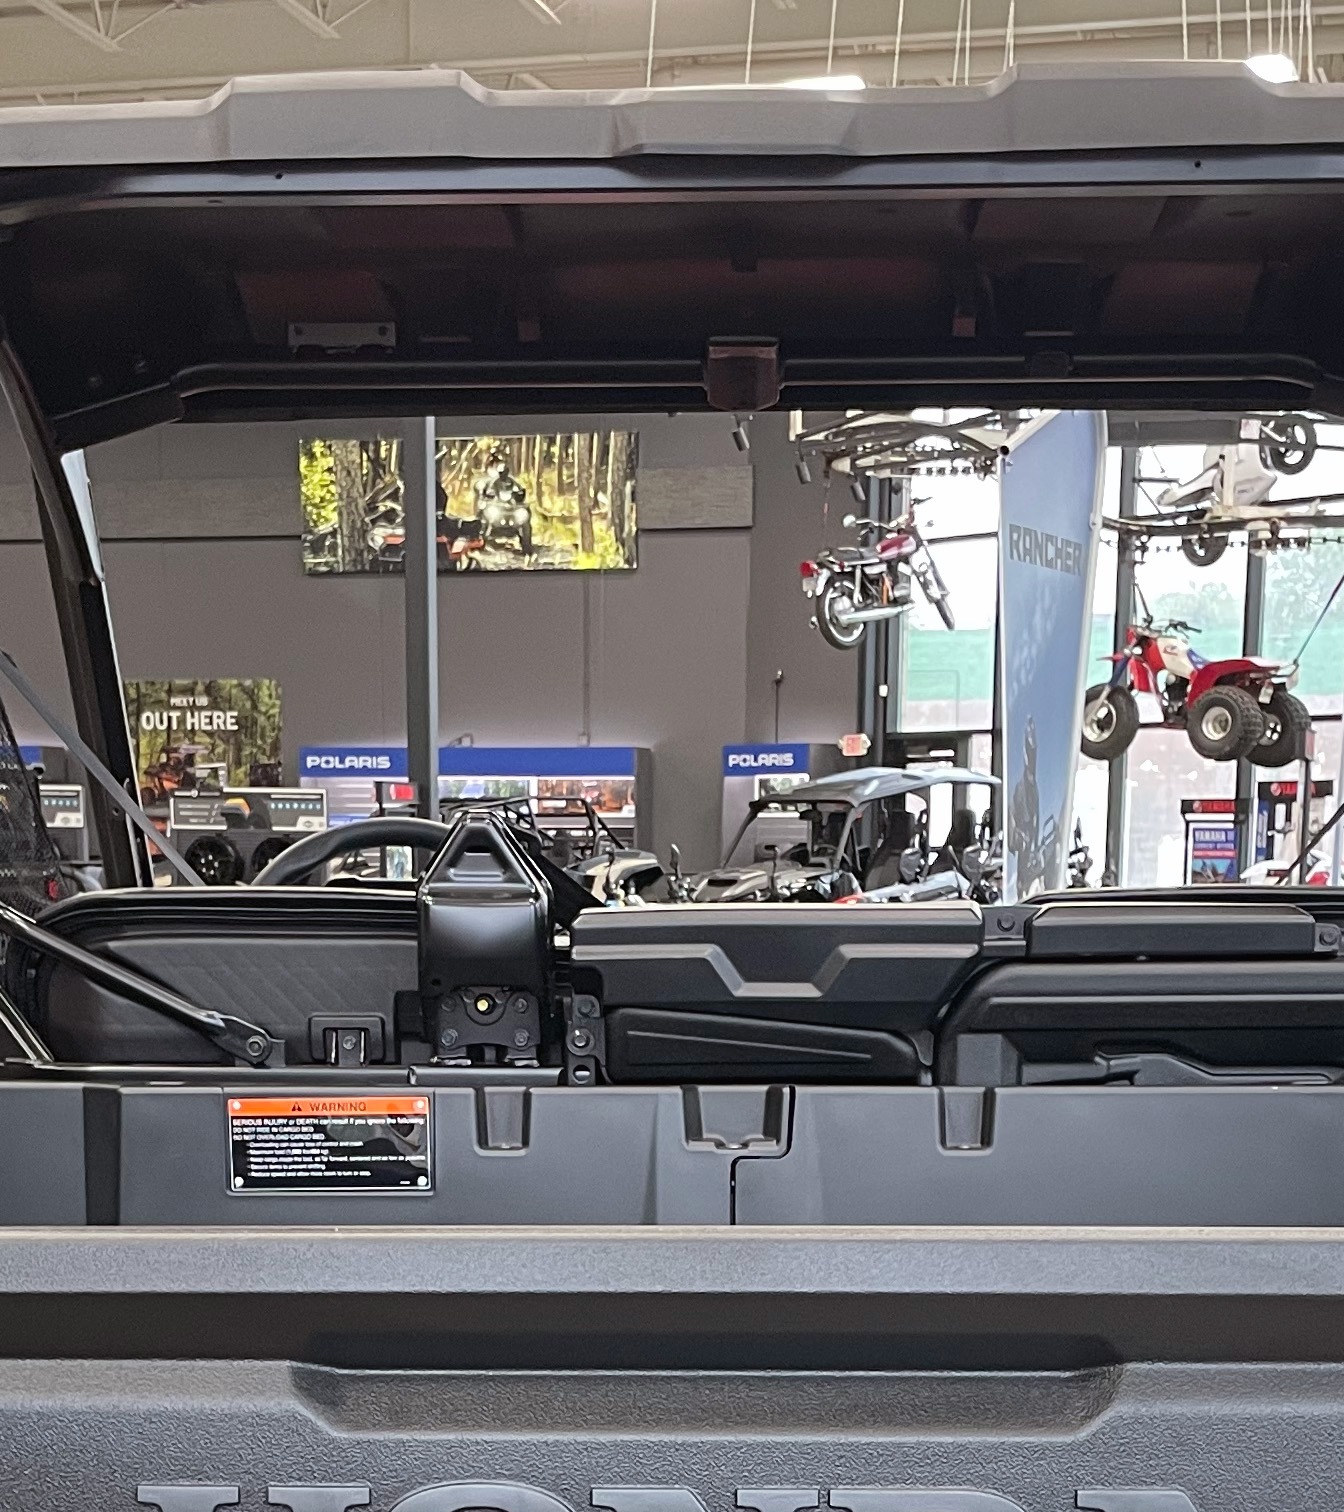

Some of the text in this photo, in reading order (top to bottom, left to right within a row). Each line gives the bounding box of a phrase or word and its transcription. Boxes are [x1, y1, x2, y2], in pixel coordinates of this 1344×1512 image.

[1008, 523, 1084, 577] RANCHER
[141, 711, 239, 731] OUT HERE
[306, 756, 391, 769] POLARIS
[728, 753, 794, 768] POLARIS
[309, 1101, 367, 1112] WARNING
